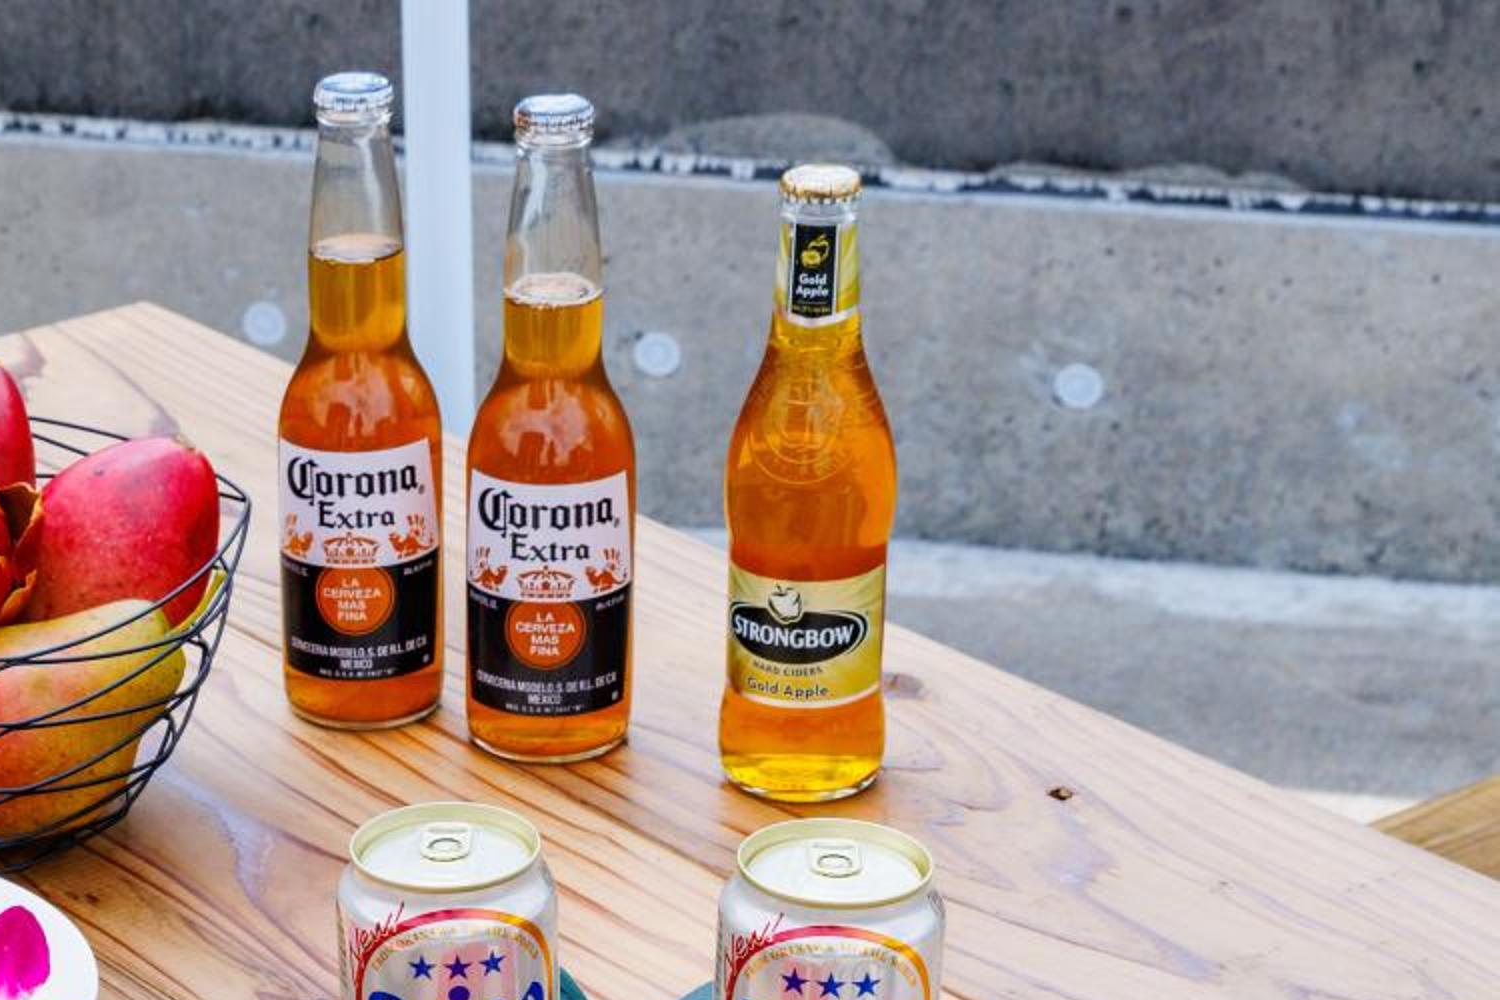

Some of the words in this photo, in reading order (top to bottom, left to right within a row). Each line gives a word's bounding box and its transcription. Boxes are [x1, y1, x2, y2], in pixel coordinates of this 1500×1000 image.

[799, 273, 827, 285] Gold
[795, 286, 830, 298] Apple
[287, 456, 418, 506] Corona
[318, 501, 395, 529] Extra
[478, 487, 614, 538] Corona
[510, 532, 590, 562] Extra
[341, 578, 360, 587] LA
[323, 588, 382, 599] CERVEZA
[337, 600, 367, 610] MAS
[337, 611, 368, 622] FINA
[535, 612, 554, 622] LA
[515, 622, 575, 633] CERVEZA
[734, 614, 855, 648] STRONGBOW
[530, 635, 560, 644] MAS
[529, 646, 560, 656] FINA
[747, 676, 779, 694] Gold
[783, 684, 830, 700] Apple
